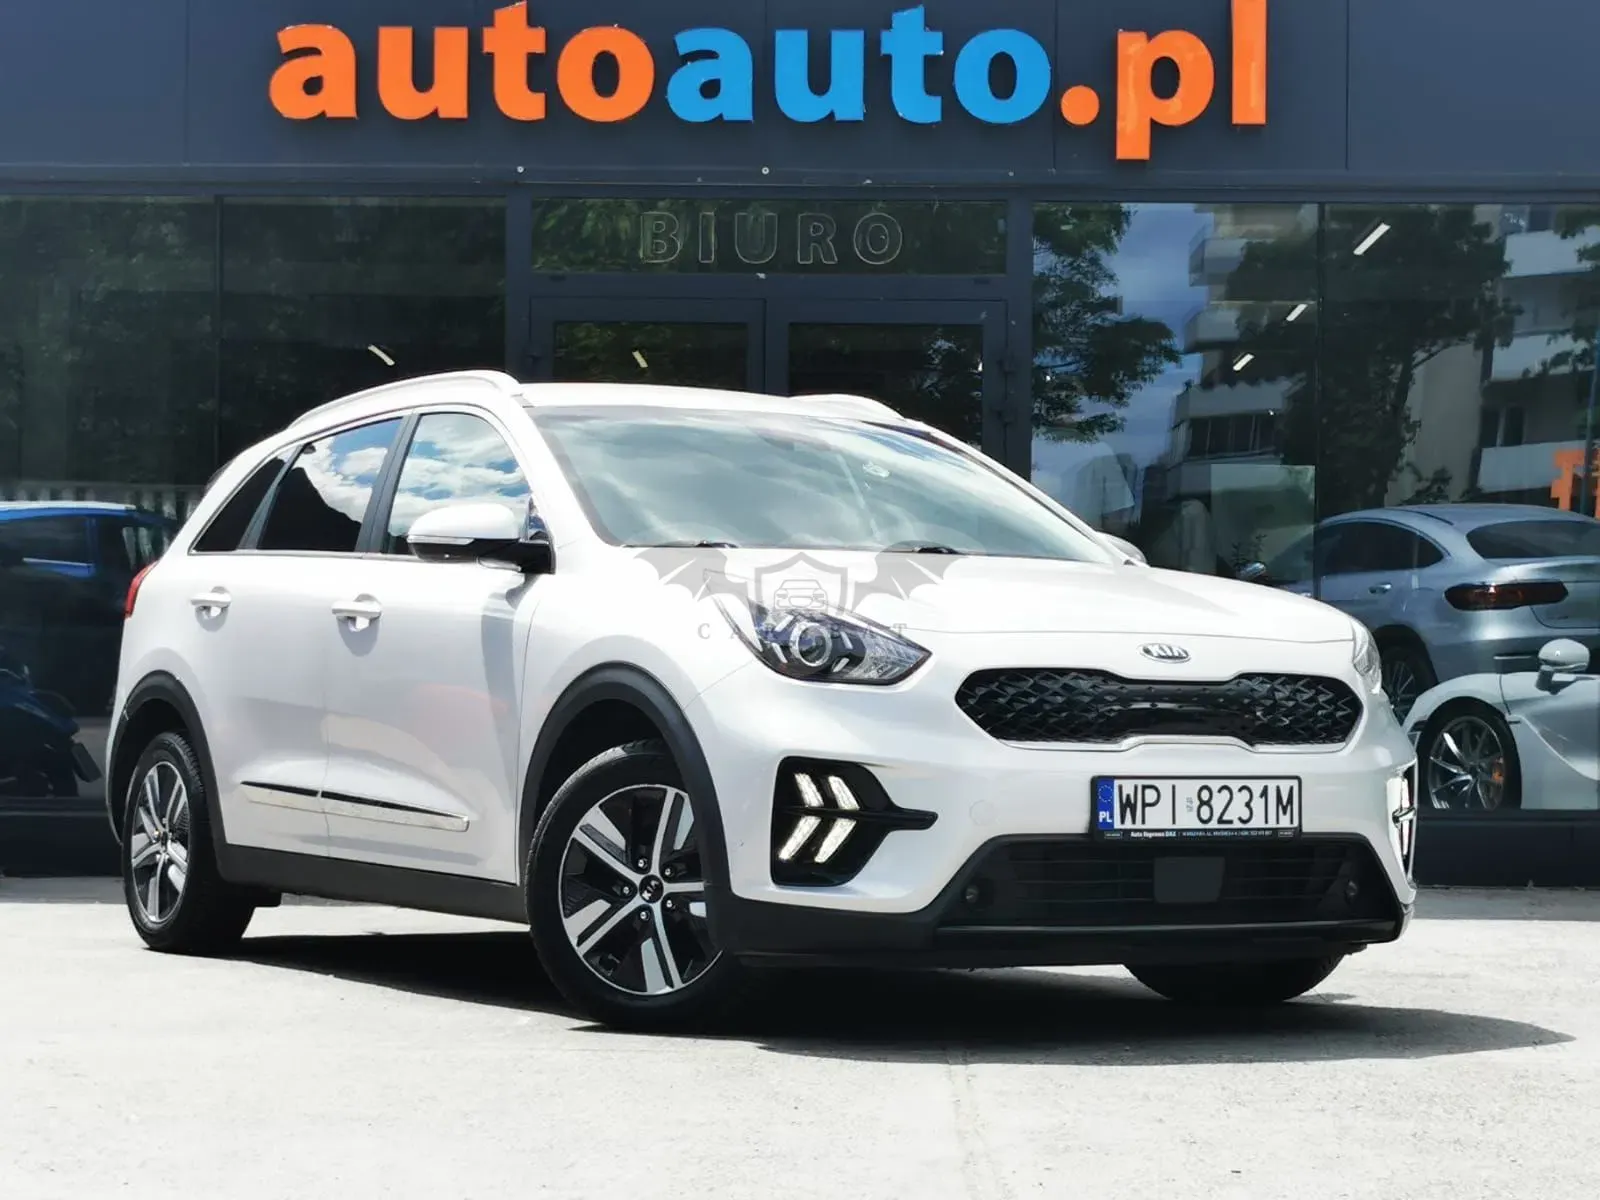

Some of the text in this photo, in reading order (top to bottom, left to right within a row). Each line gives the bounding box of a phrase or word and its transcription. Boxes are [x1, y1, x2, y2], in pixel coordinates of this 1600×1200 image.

[269, 0, 1267, 160] autoauto.pl
[640, 211, 903, 265] BIURO
[1099, 811, 1112, 823] PL
[1118, 784, 1176, 825] WPI
[1196, 785, 1294, 825] 8231M
